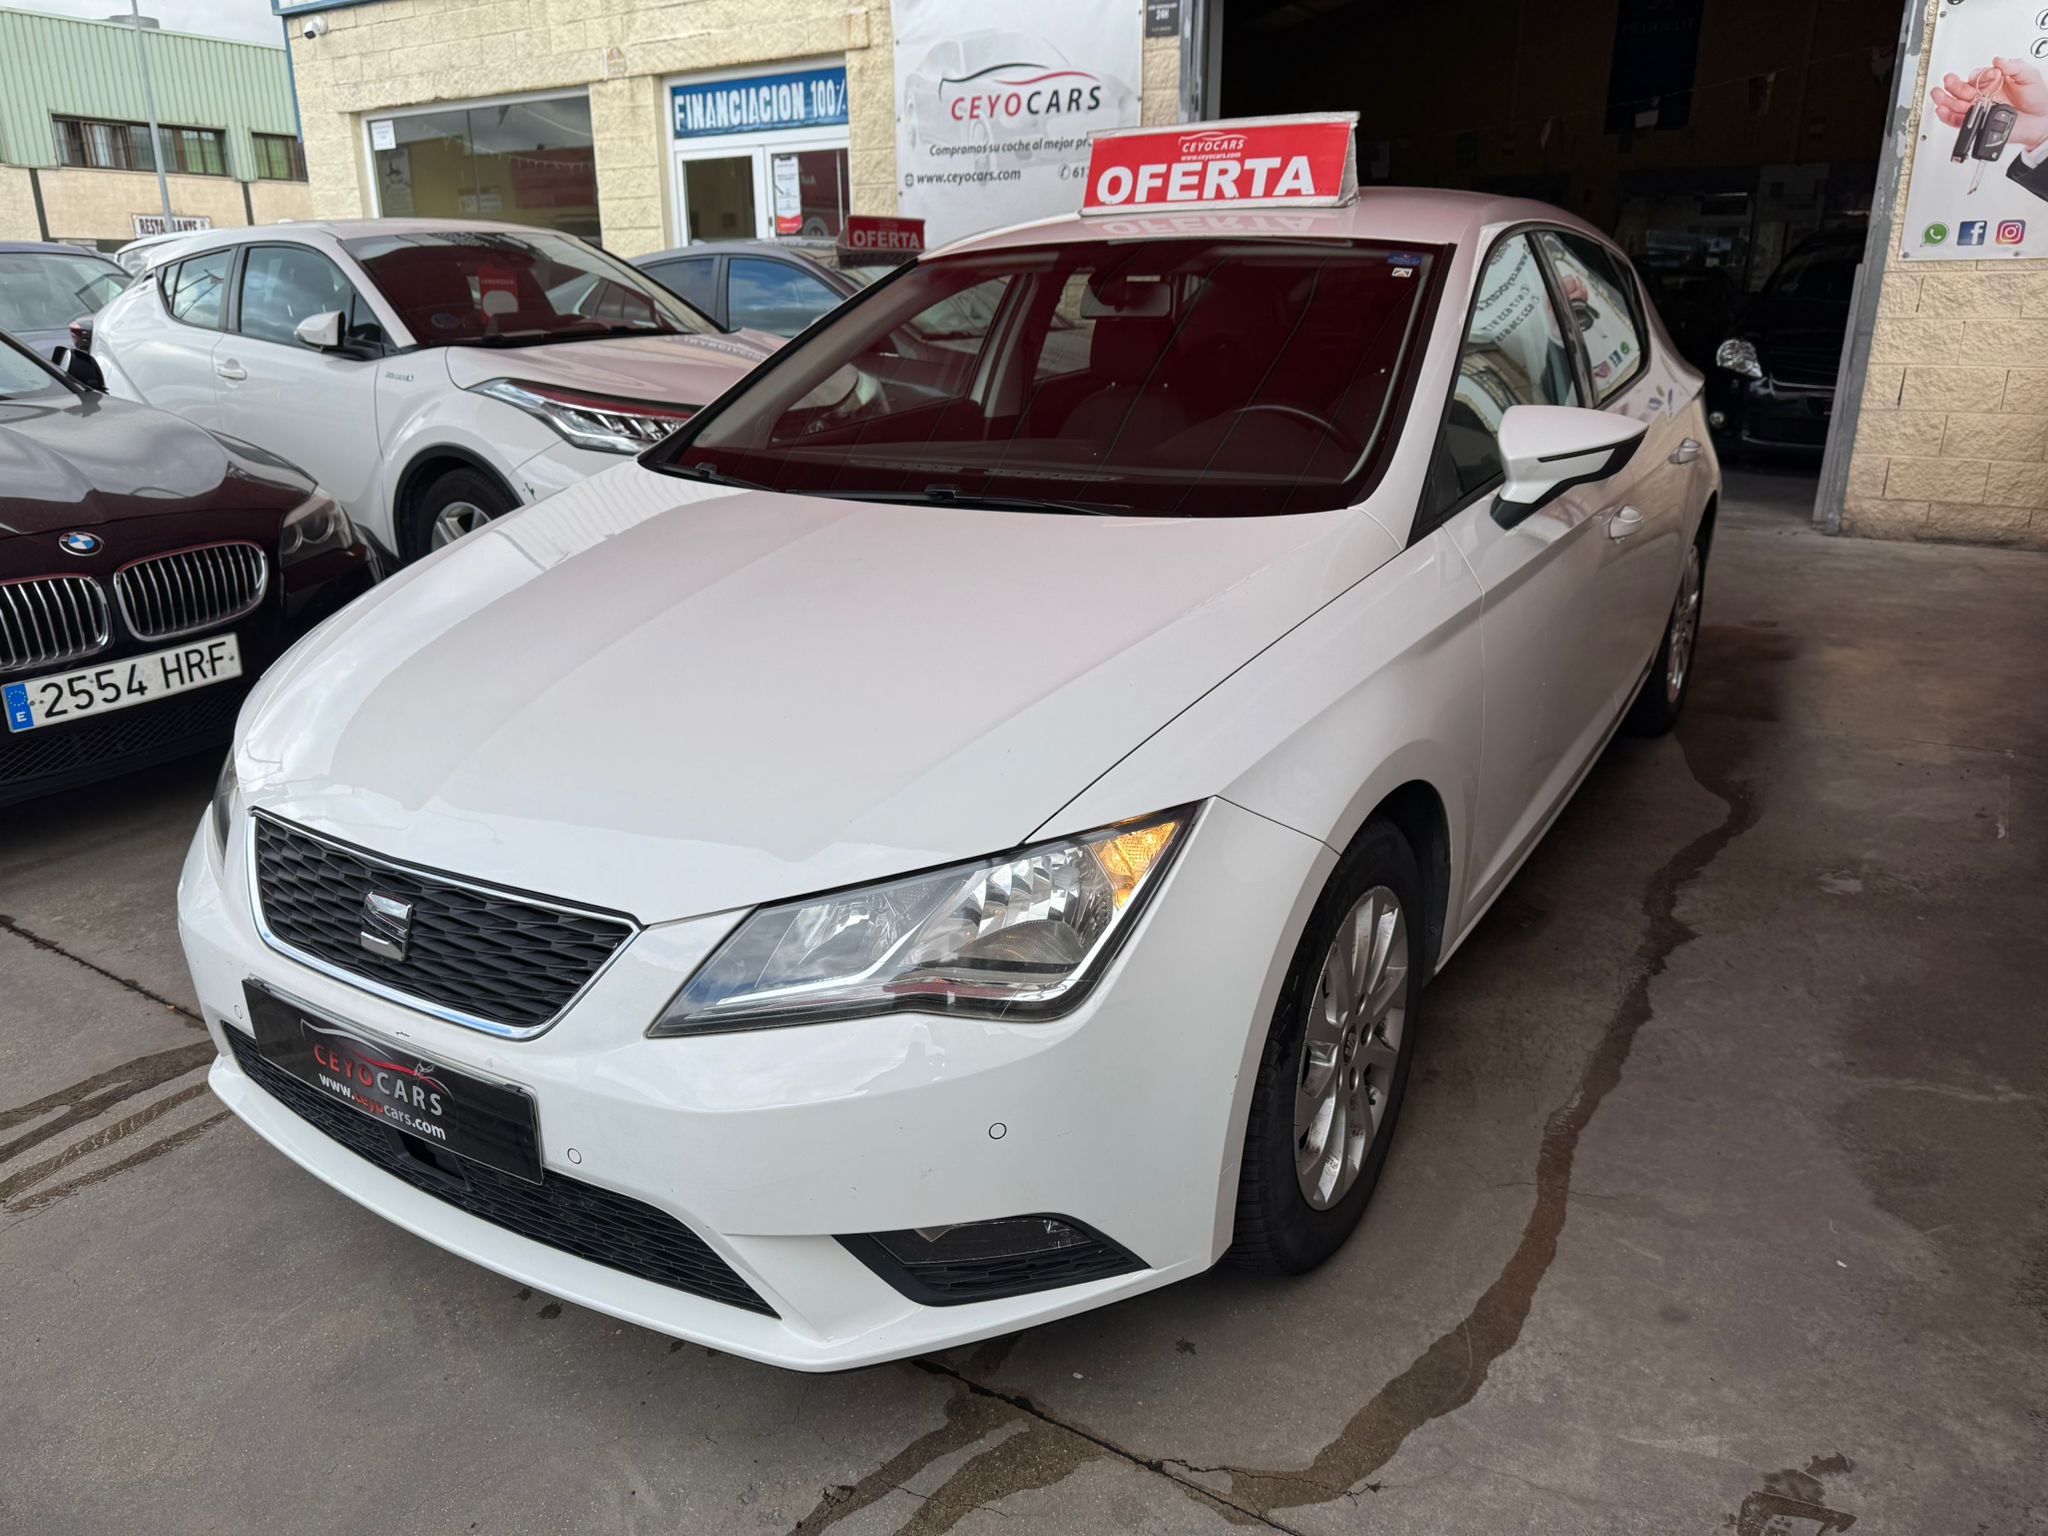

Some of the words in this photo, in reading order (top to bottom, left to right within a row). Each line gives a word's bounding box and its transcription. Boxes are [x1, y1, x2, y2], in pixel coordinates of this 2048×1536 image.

[674, 82, 805, 131] FINANCIACION
[810, 79, 847, 118] 100%
[951, 86, 1102, 121] CEYOCARS
[930, 142, 987, 158] Compramos
[988, 143, 1001, 152] su
[1002, 139, 1028, 152] coche
[1031, 138, 1043, 151] al
[1044, 136, 1074, 151] mejor
[1182, 139, 1245, 153] CEYOCARS
[916, 169, 1021, 187] www.ceyocars.com
[1096, 156, 1316, 205] OFERTA
[853, 230, 920, 249] OFERTA
[40, 663, 148, 719] 2554
[160, 641, 226, 690] HRF
[16, 711, 27, 723] E
[314, 1044, 443, 1116] CEYOCARS
